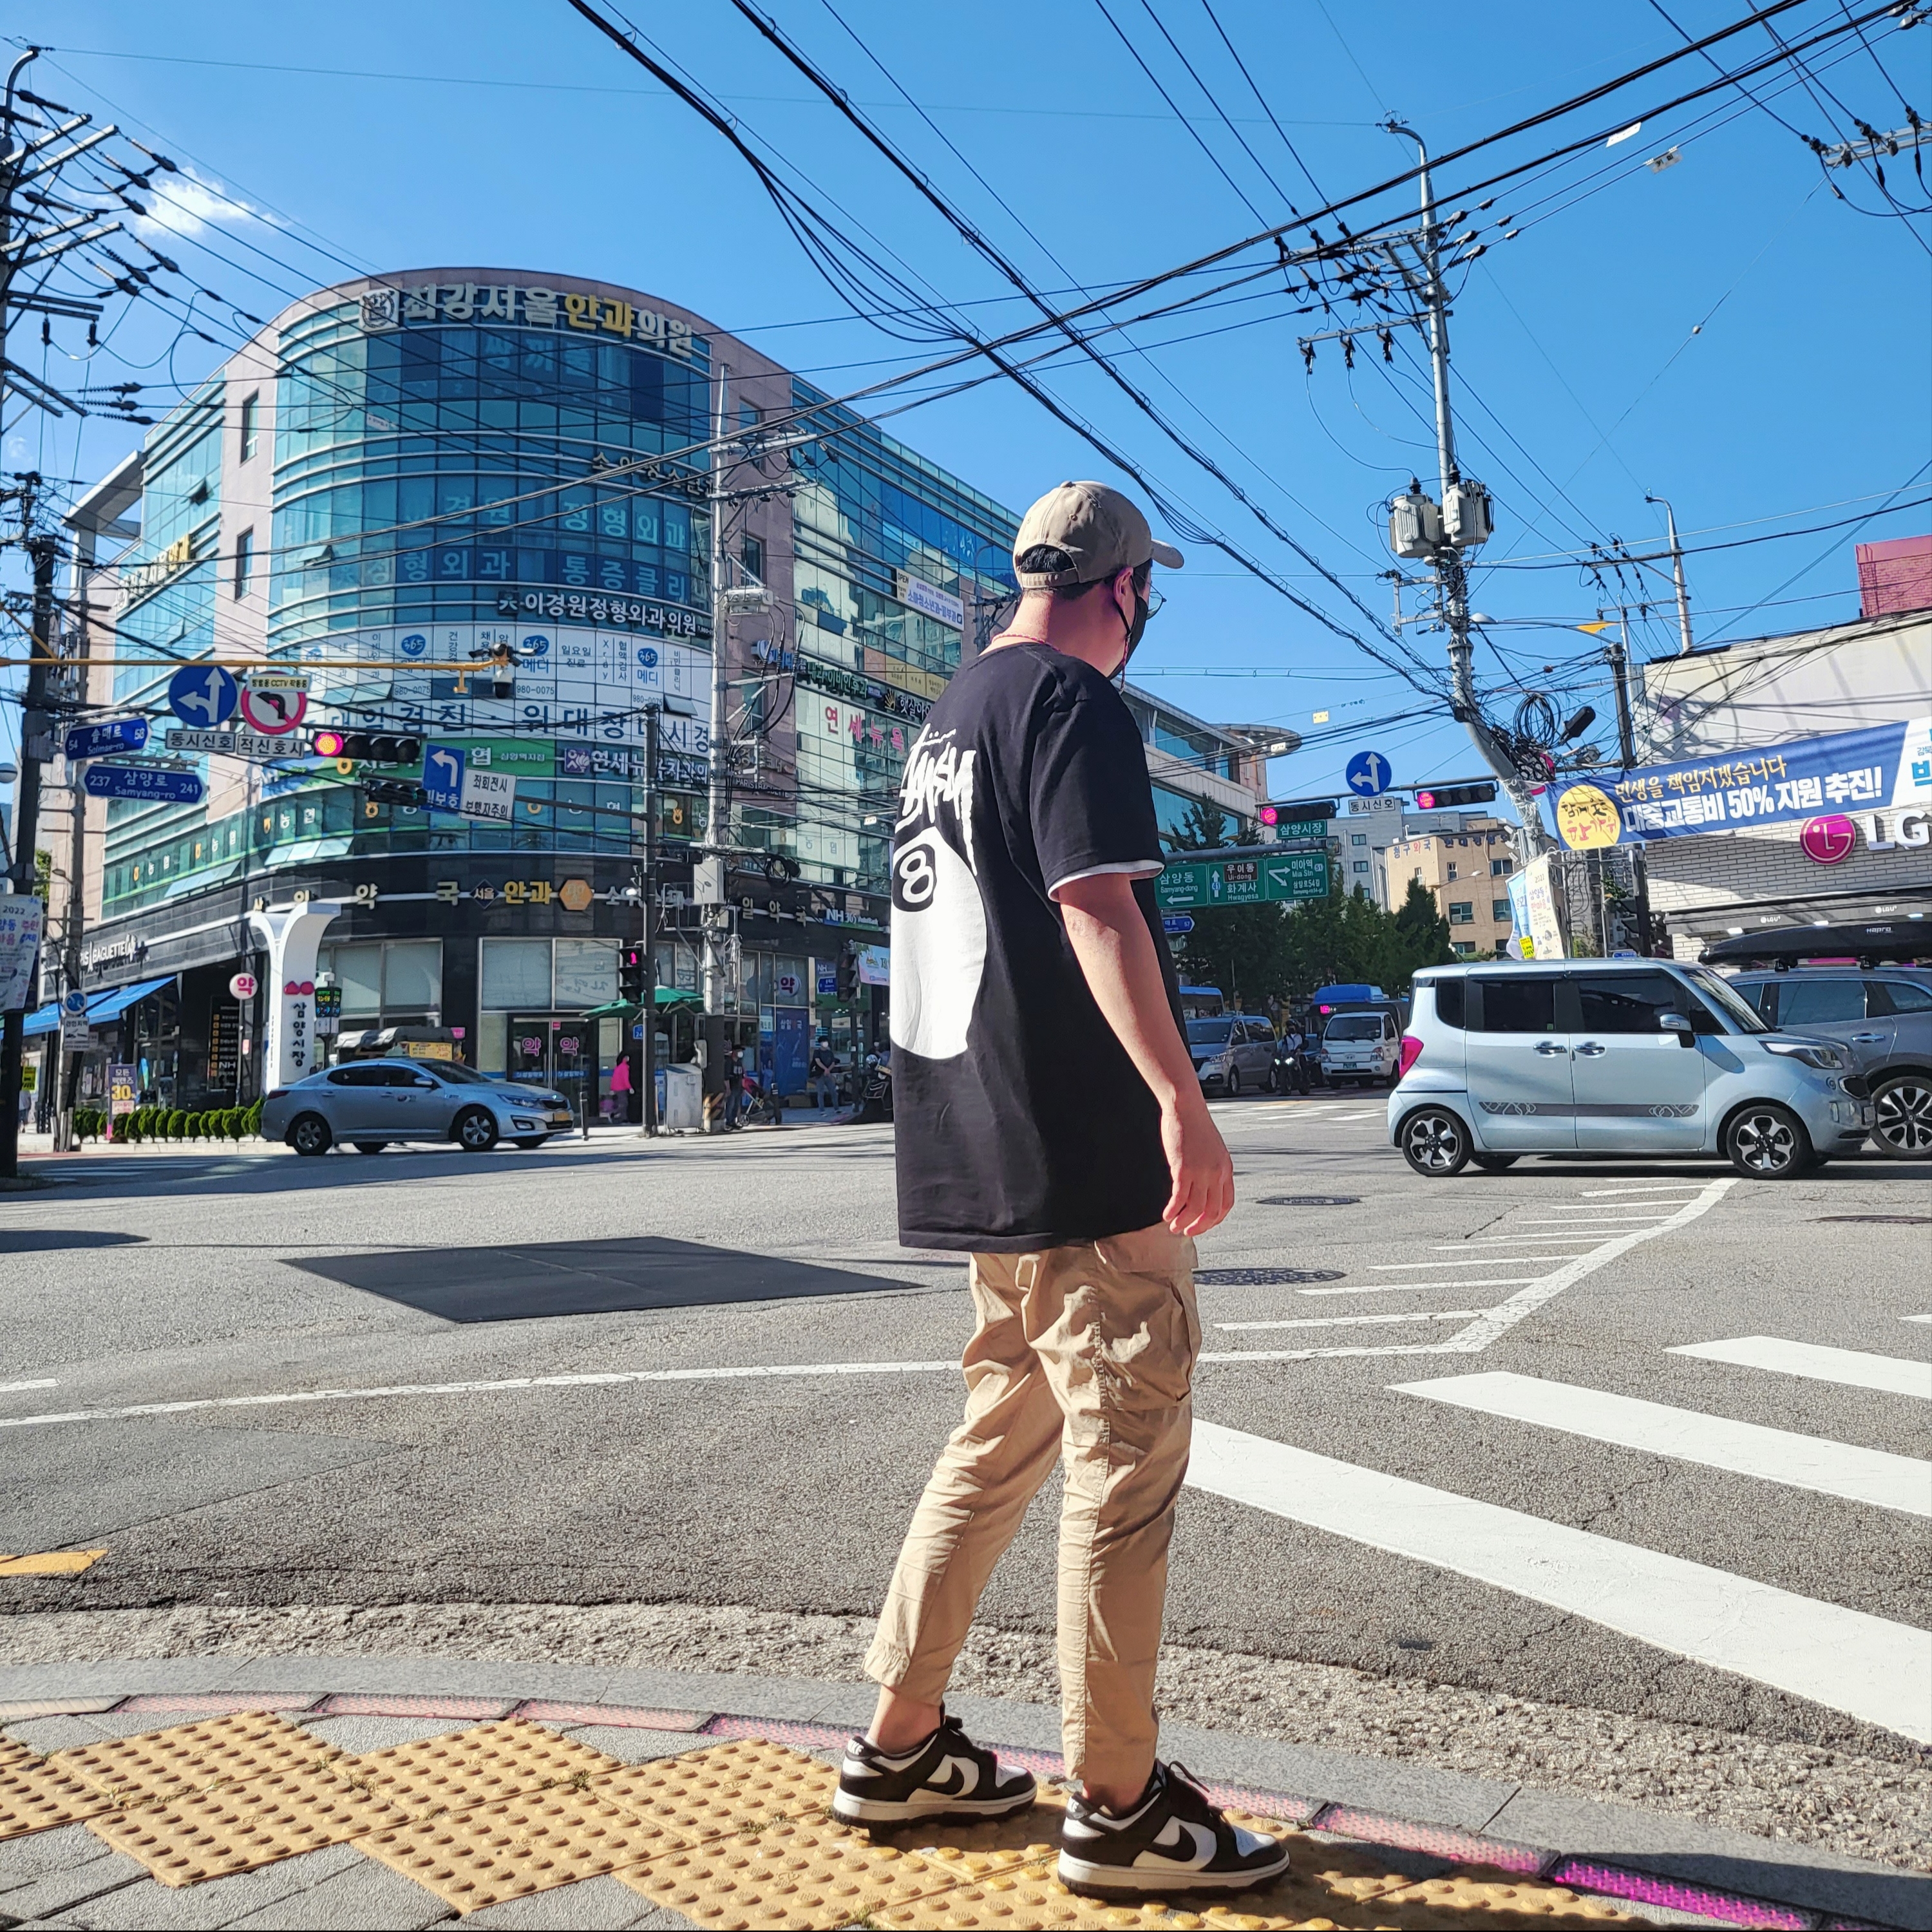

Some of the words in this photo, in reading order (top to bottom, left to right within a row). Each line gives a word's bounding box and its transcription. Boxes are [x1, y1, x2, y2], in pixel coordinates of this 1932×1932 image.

[525, 592, 697, 636] 이경원정형외과의원
[562, 645, 591, 656] 일요일
[638, 650, 657, 663] 365
[522, 657, 549, 674] 메디
[637, 669, 658, 686] 메디
[516, 685, 555, 696] 980-0075
[633, 694, 663, 706] 980-0075
[171, 732, 232, 749] 동시신호
[240, 737, 303, 757] 적신호시
[90, 775, 111, 787] 237
[123, 771, 169, 787] 삼양로
[473, 774, 507, 793] 좌회전시
[1615, 776, 1664, 803] 민생을
[1667, 755, 1787, 795] 책임지겠습니다
[115, 786, 176, 800] Samyang-ro
[180, 782, 198, 795] 241
[1350, 799, 1394, 812] 동시신호
[1622, 791, 1727, 833] 대중교통비
[1727, 784, 1775, 819] 50%
[1775, 776, 1824, 812] 지원
[1824, 766, 1882, 804] 추진!
[1279, 822, 1323, 835] 삼양시장
[1865, 808, 1931, 851] LG
[1226, 862, 1255, 873] 우이동
[1291, 858, 1313, 871] 미아역
[1159, 871, 1195, 886] 삼양동
[1227, 873, 1252, 882] Ui-dong
[474, 887, 495, 900] 서울
[504, 880, 551, 904] 안과
[1160, 885, 1198, 895] Samyang-dong
[1227, 881, 1257, 894] 화계사
[1227, 893, 1259, 902] Hwagyesa
[2, 905, 26, 916] 2022
[826, 908, 844, 923] NH
[237, 977, 255, 996] 약
[781, 977, 795, 994] 약
[292, 1001, 307, 1067] 삼양시장
[522, 1036, 542, 1057] 약
[560, 1036, 580, 1056] 약
